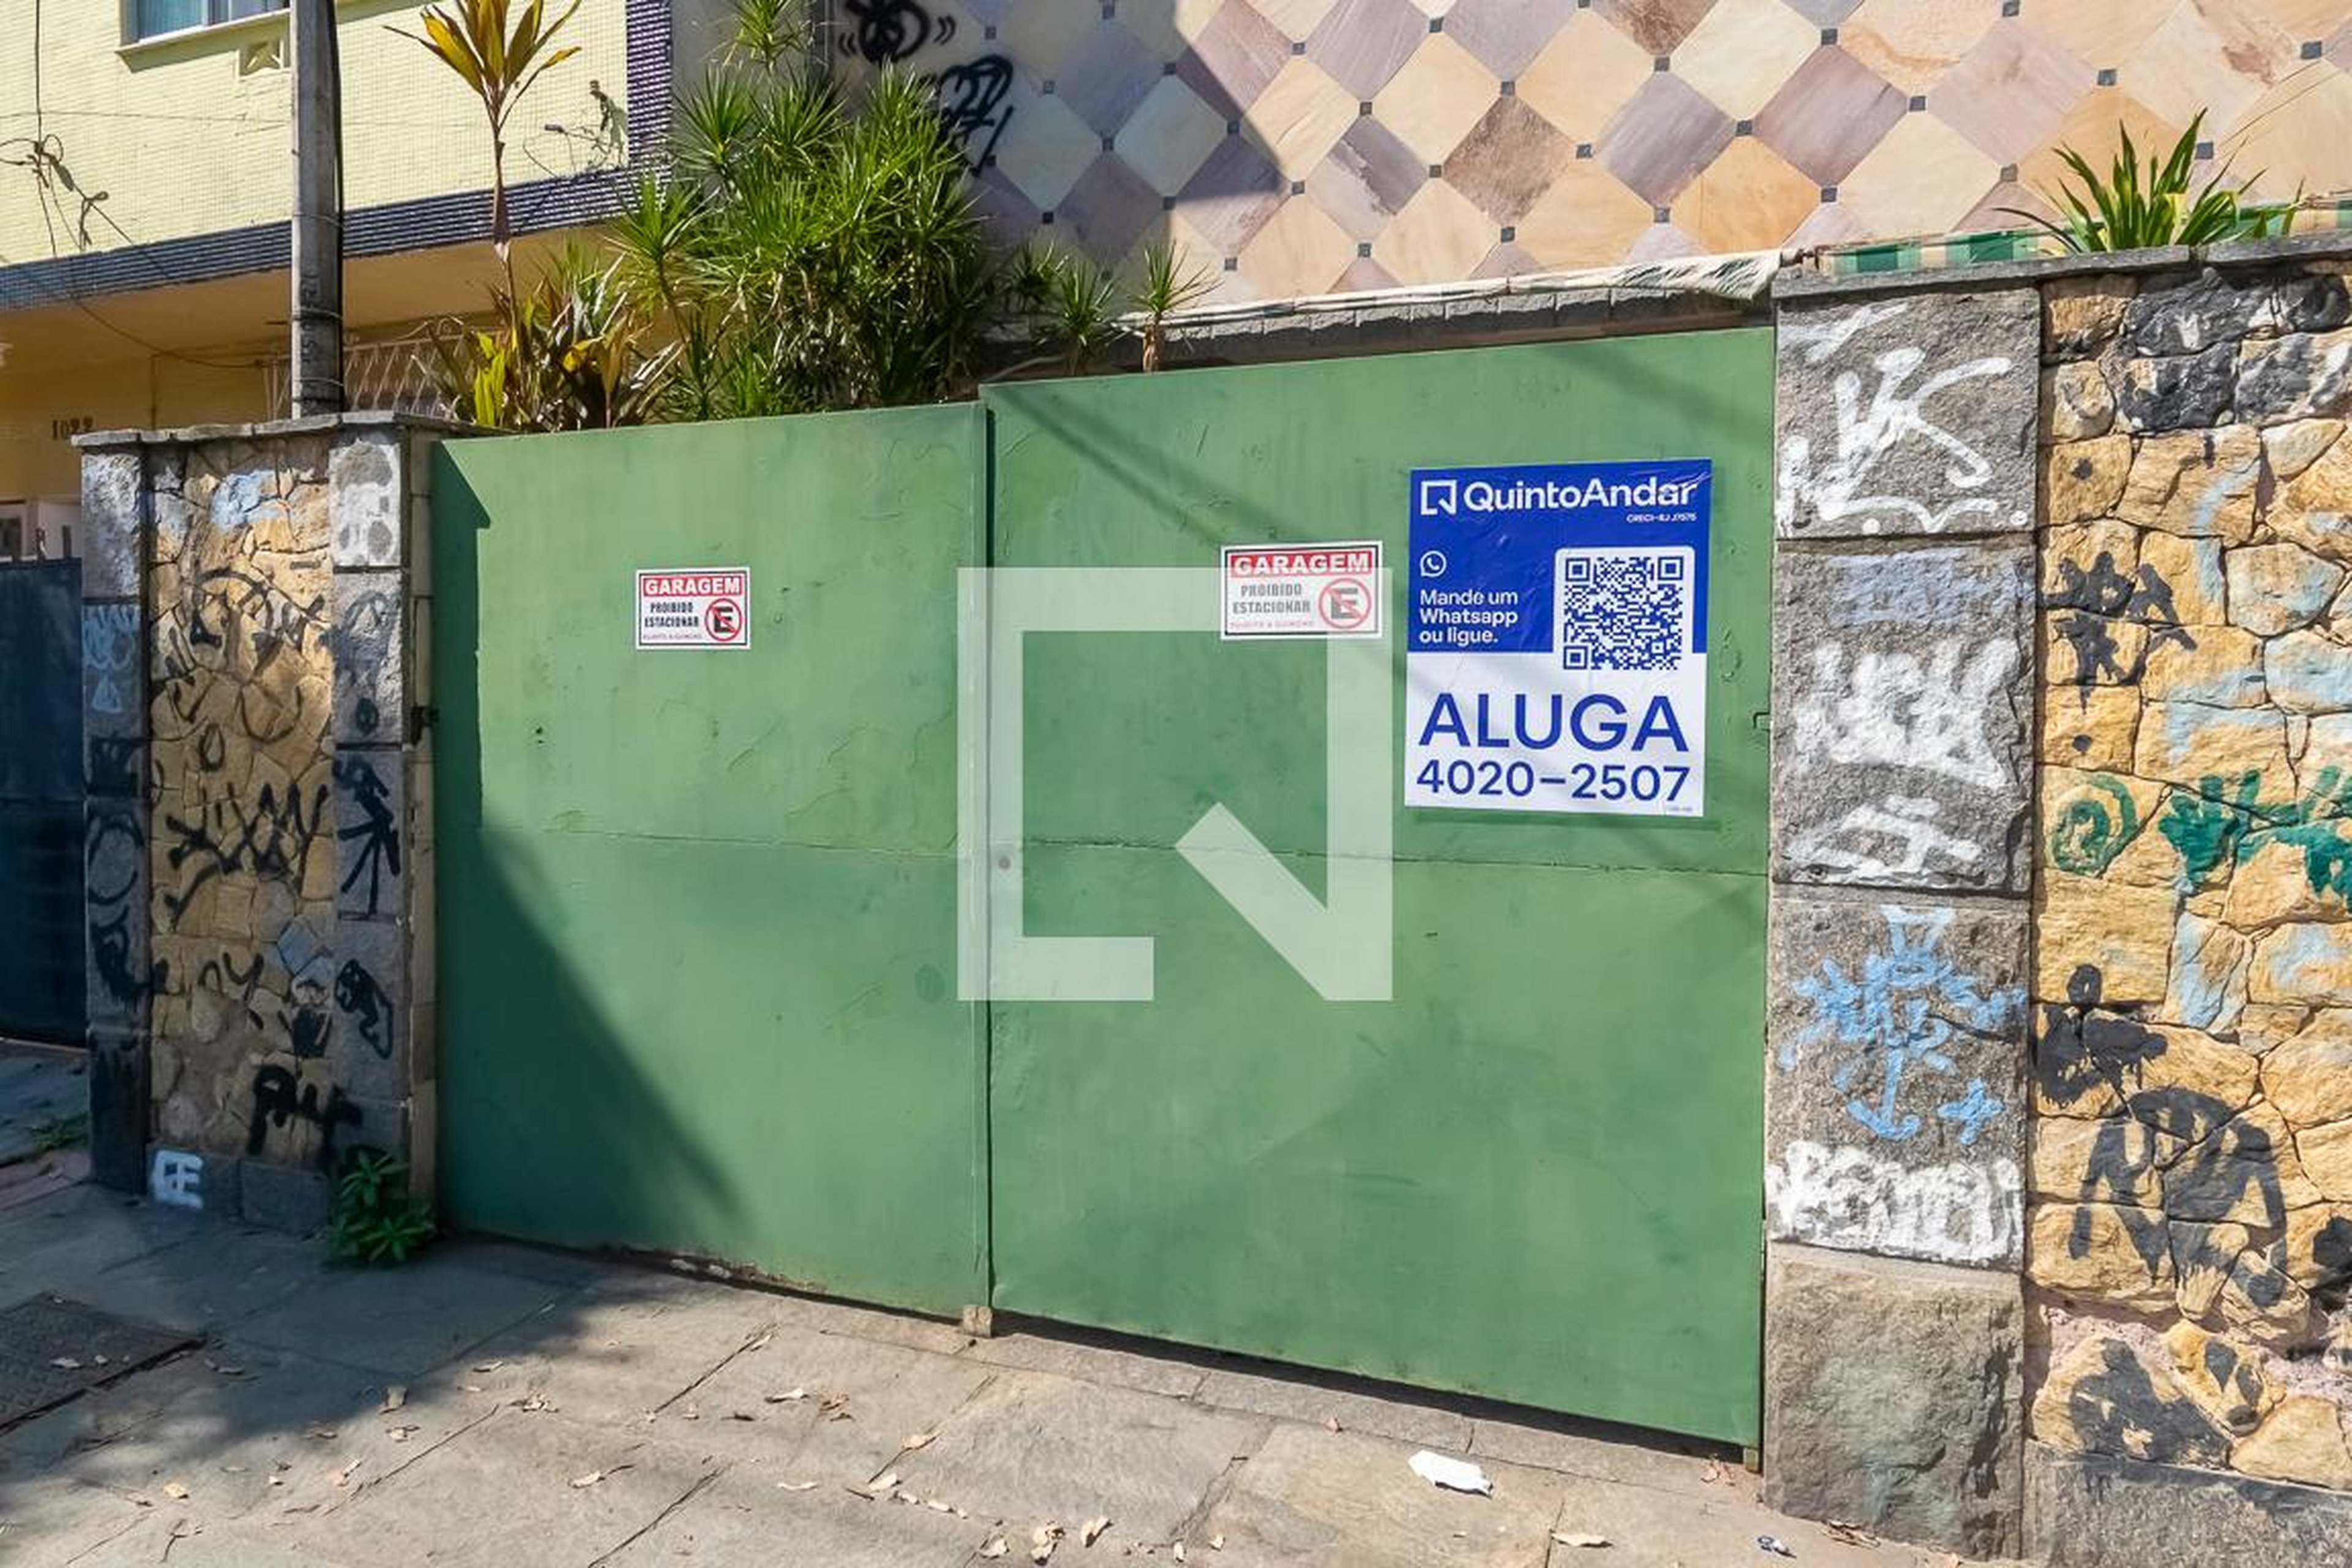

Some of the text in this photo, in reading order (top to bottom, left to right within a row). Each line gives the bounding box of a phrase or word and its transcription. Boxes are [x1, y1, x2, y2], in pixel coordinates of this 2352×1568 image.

[1463, 477, 1697, 512] QuintoAndar
[1234, 553, 1368, 575] GARAGEM
[645, 577, 740, 595] GARAGEM
[1241, 584, 1302, 597] PROIBIDO
[1420, 589, 1518, 605] Mande um
[650, 601, 693, 613] PROIBIDO
[1233, 600, 1311, 614] ESTACIONAR
[645, 616, 699, 628] ESTACIONAR
[1420, 608, 1518, 628] Whatsapp
[1419, 627, 1498, 647] ou ligue.
[1419, 693, 1689, 752] ALUGA
[1417, 760, 1691, 802] 4020-2507
